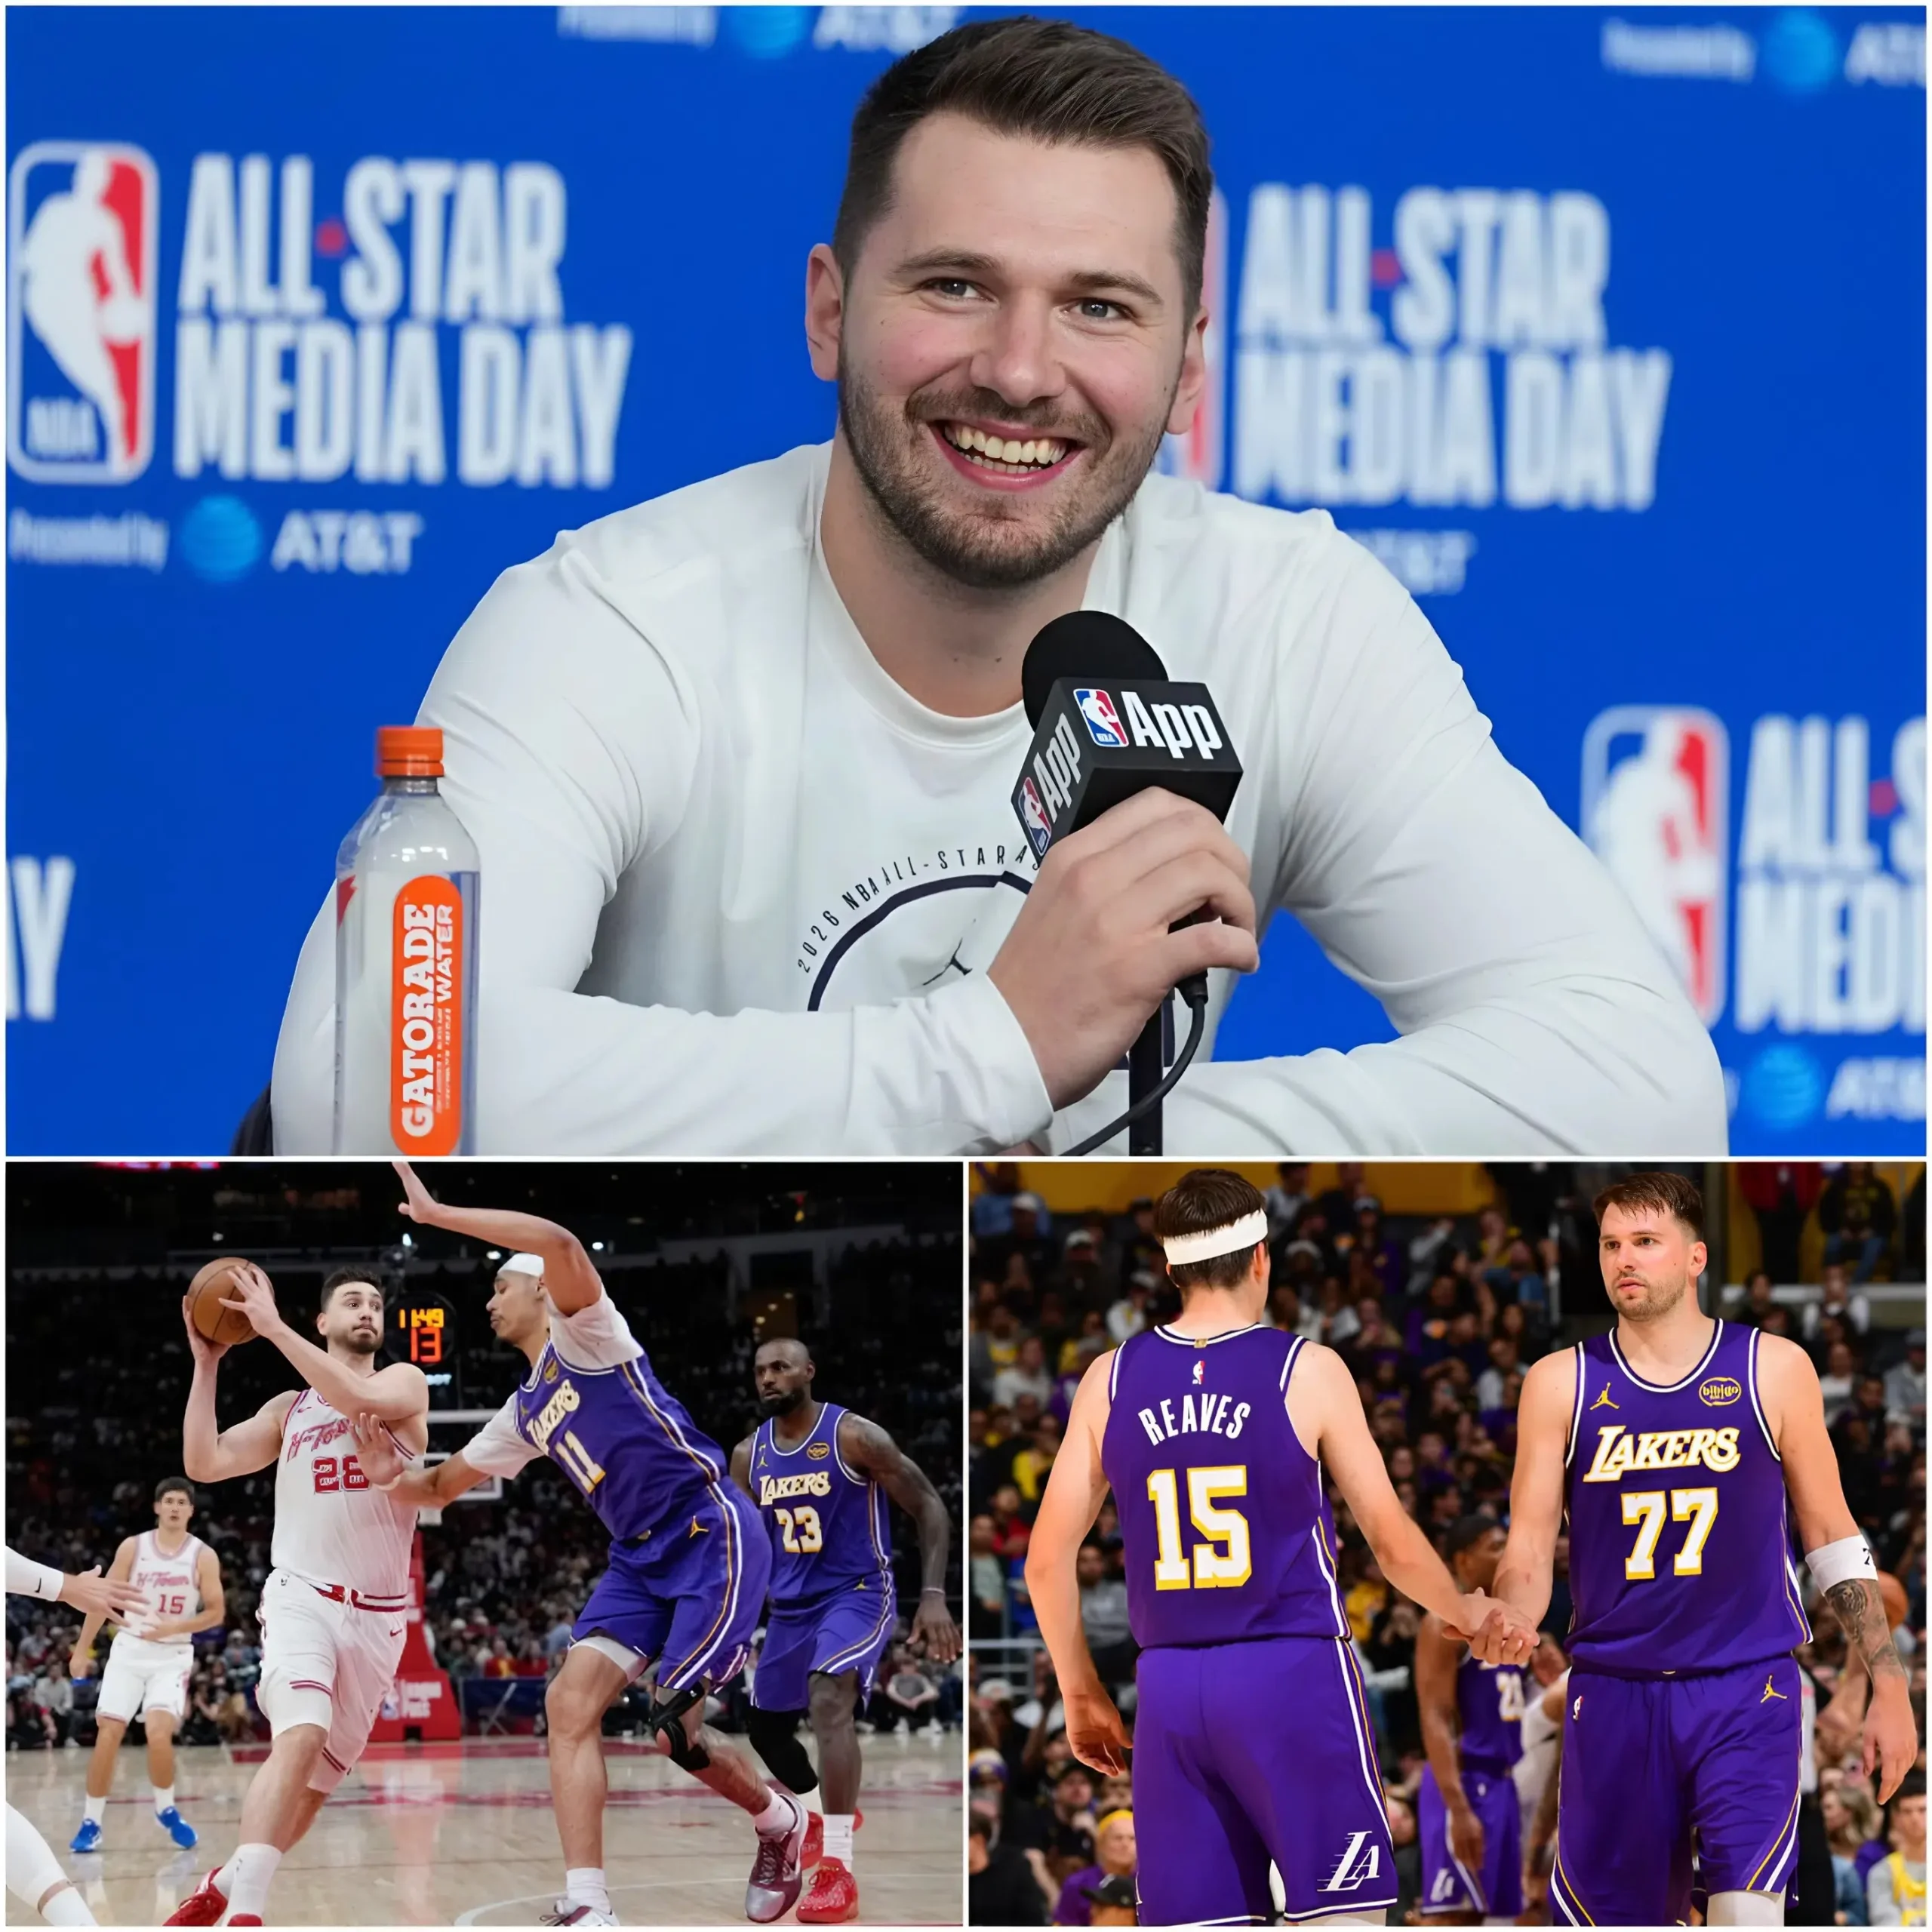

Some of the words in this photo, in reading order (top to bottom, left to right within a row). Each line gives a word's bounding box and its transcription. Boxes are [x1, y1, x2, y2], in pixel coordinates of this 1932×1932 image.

[174, 315, 447, 485] MEDIA
[457, 323, 634, 488] DAY
[1233, 343, 1497, 508] MEDIA
[1505, 345, 1672, 512] DAY
[271, 510, 423, 574] AT&T
[1121, 691, 1223, 760] App
[1033, 712, 1081, 824] App
[436, 905, 454, 1004] WATER
[798, 910, 839, 973] 2026
[841, 877, 880, 910] NBA
[1735, 875, 1926, 1035] MEDI
[401, 903, 435, 1137] GATORADE
[411, 1327, 441, 1362] 13
[1138, 1393, 1251, 1446] REAVES
[1583, 1426, 1741, 1482] LAKERS
[555, 1430, 606, 1494] 11
[759, 1472, 832, 1506] LAKERS
[774, 1506, 823, 1553] 23
[1147, 1465, 1252, 1591] 15
[1620, 1487, 1718, 1580] 77
[158, 1593, 186, 1614] 15
[1317, 1831, 1380, 1892] LA
